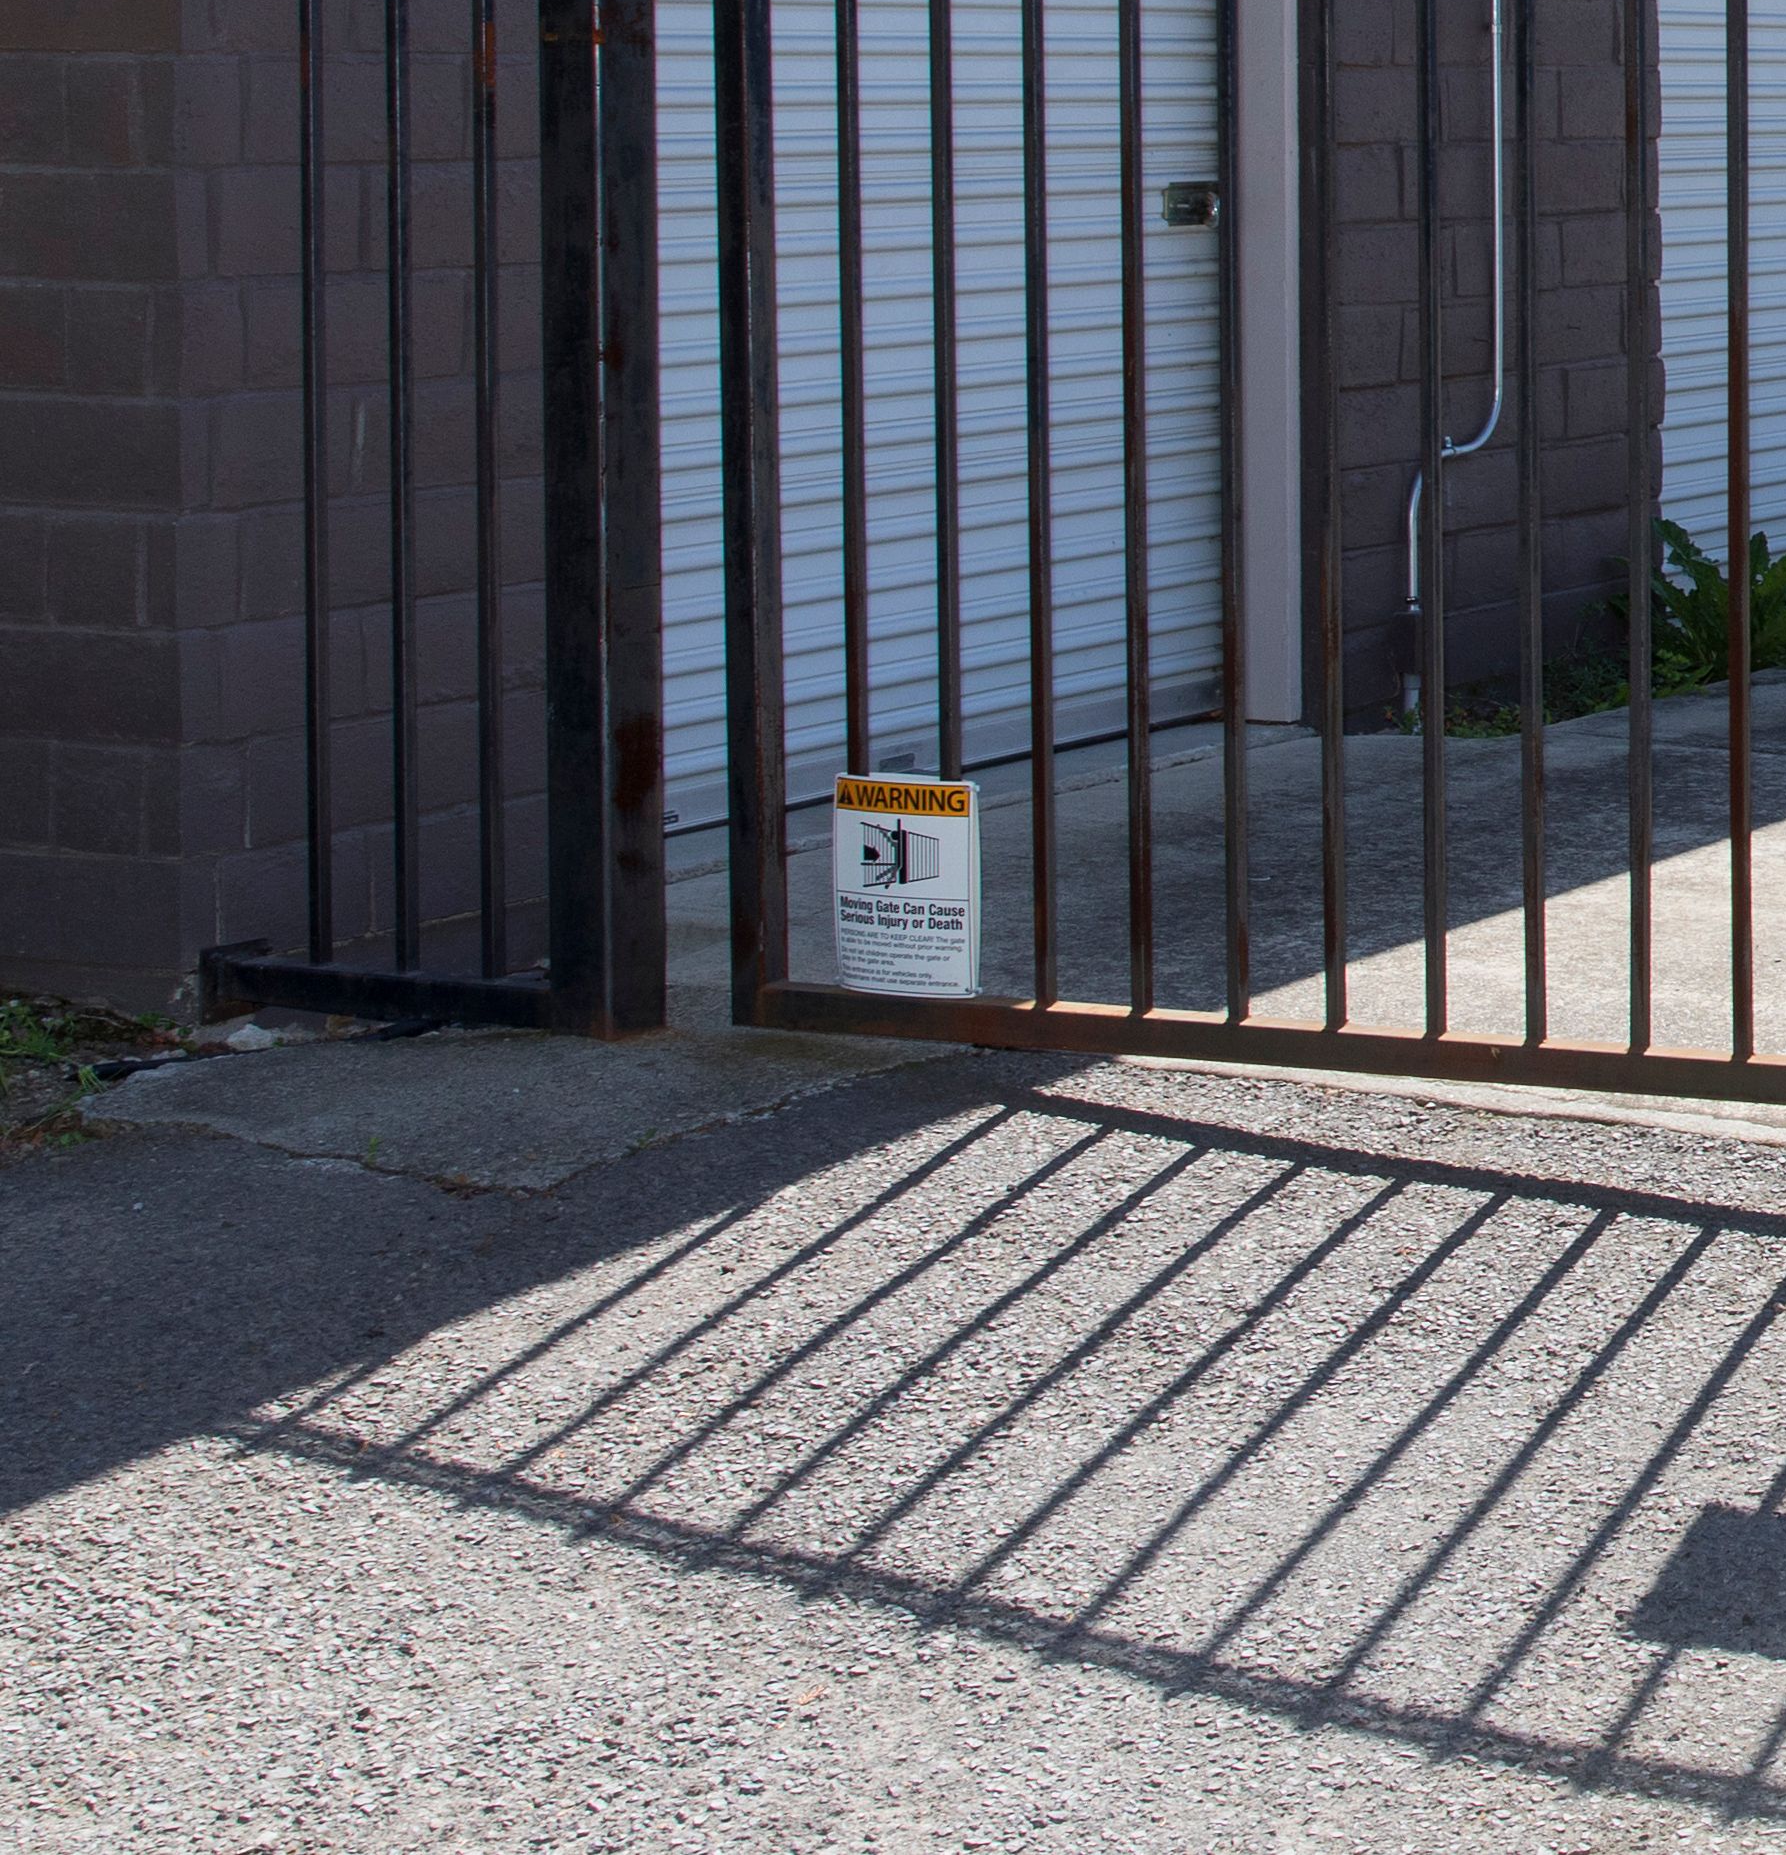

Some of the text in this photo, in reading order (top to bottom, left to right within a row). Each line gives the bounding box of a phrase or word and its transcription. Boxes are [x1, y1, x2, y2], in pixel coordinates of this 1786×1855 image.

[855, 784, 966, 813] WARNING
[839, 895, 966, 918] Moving Gate Can Cause
[839, 909, 964, 931] Serious Injury or Death
